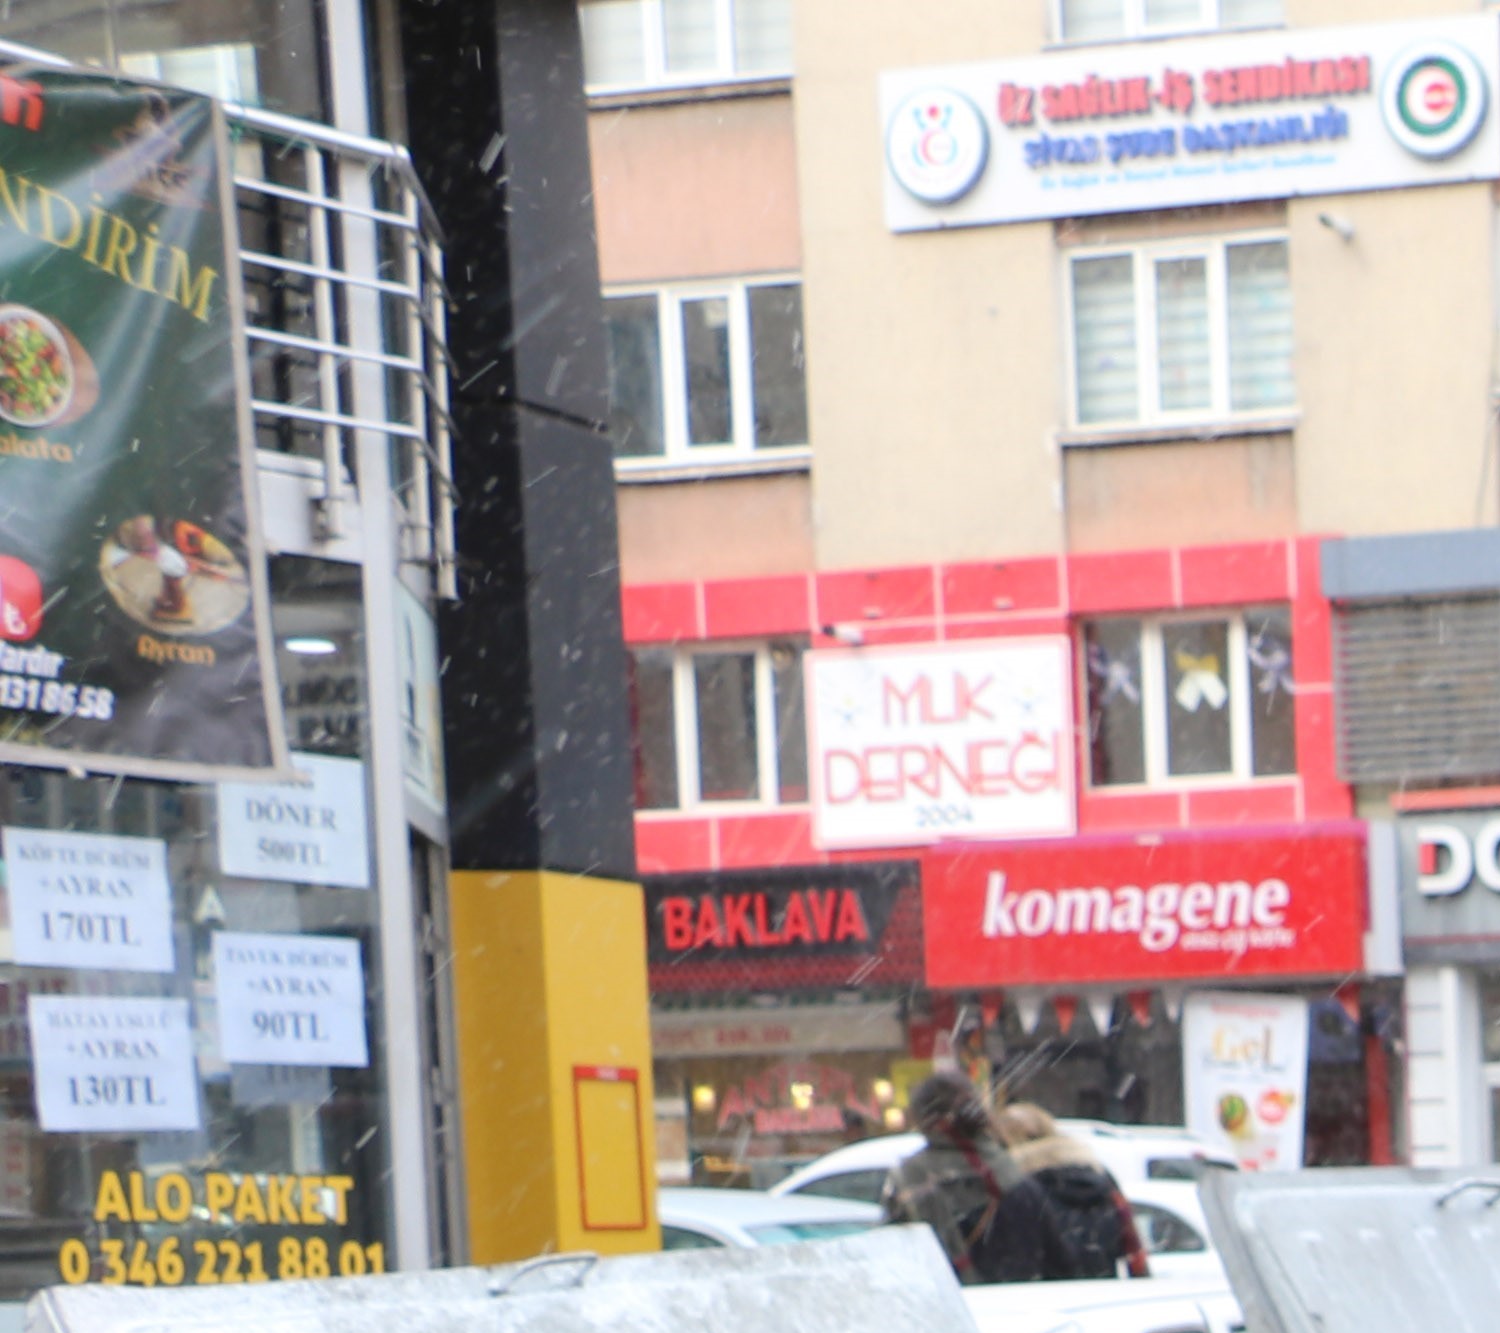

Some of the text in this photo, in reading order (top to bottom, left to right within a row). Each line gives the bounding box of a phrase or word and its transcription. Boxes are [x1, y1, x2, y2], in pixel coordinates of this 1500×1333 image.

[1202, 54, 1372, 108] SENDİKASI
[245, 795, 338, 831] DÖNER
[40, 911, 142, 948] 170TL
[662, 888, 870, 950] BAKLAVA
[982, 869, 1292, 952] komagene
[250, 1010, 330, 1043] 90TL
[68, 1073, 166, 1108] 130TL
[94, 1170, 354, 1225] ALO PAKET
[59, 1235, 385, 1287] 0 346 221 88 01
